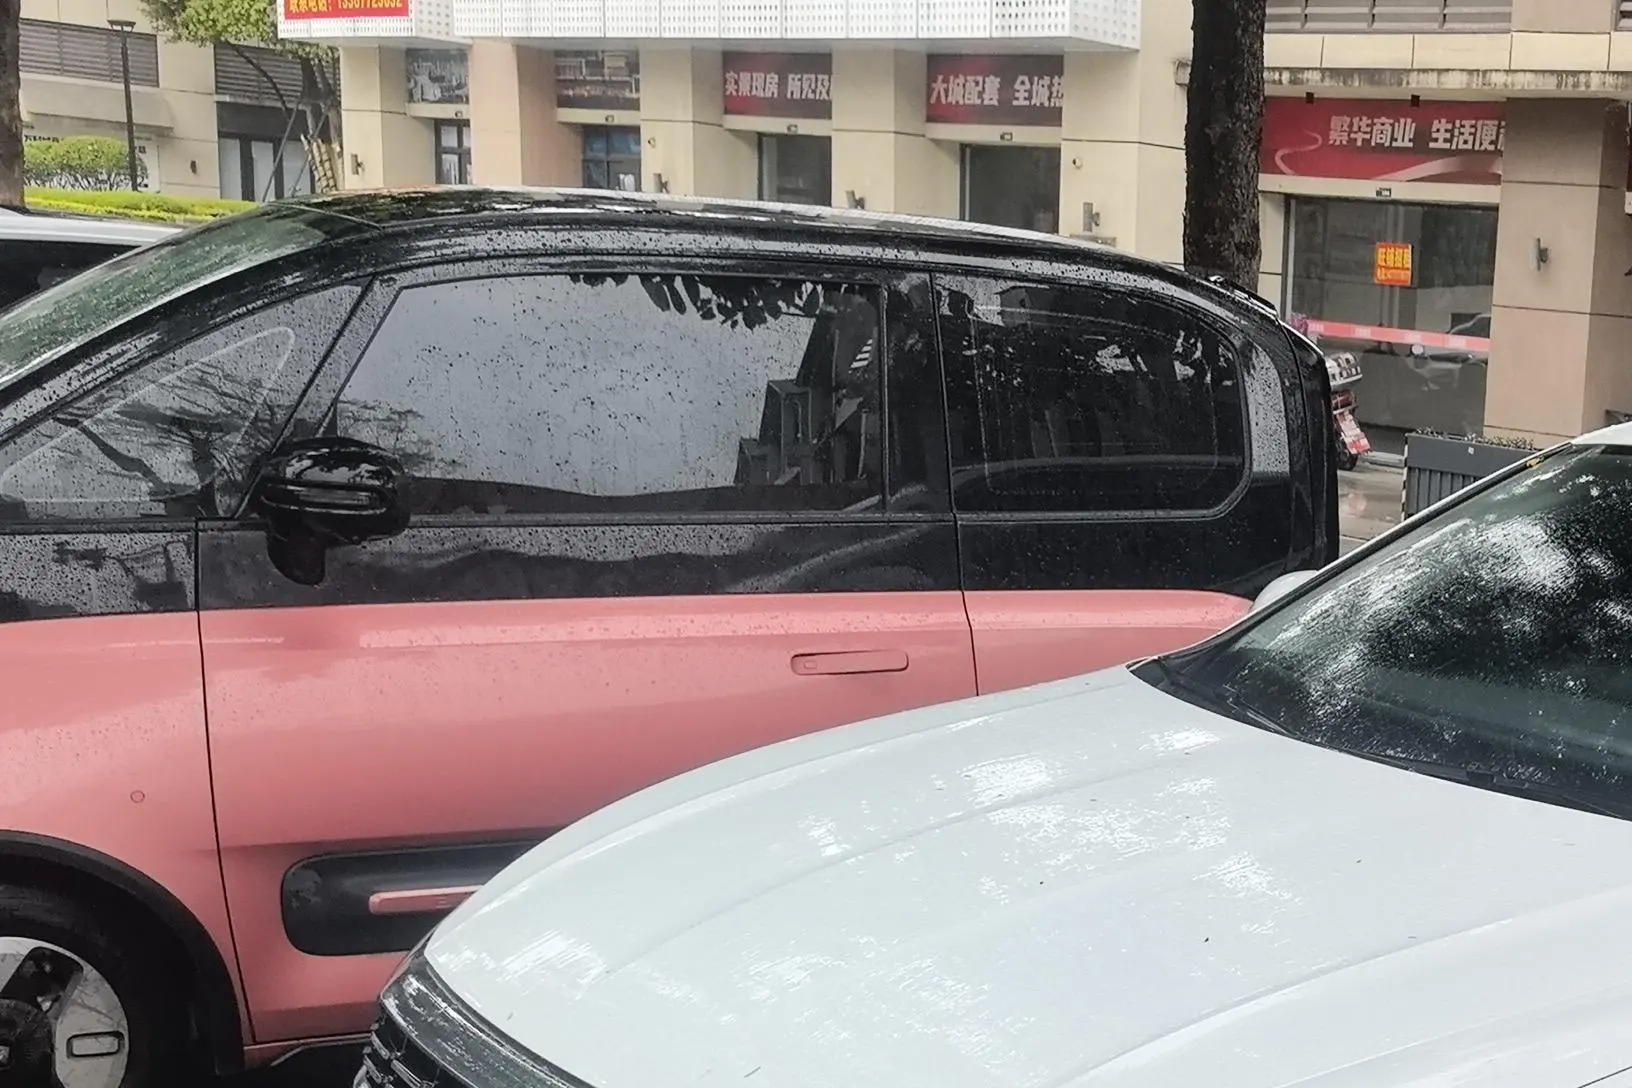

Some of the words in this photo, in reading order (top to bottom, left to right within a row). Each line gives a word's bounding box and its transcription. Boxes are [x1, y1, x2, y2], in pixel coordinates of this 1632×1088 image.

[787, 73, 833, 100] 所见及
[930, 74, 1001, 105] 大城配套
[1329, 115, 1416, 148] 繁华商业
[1429, 118, 1506, 151] 生活便
